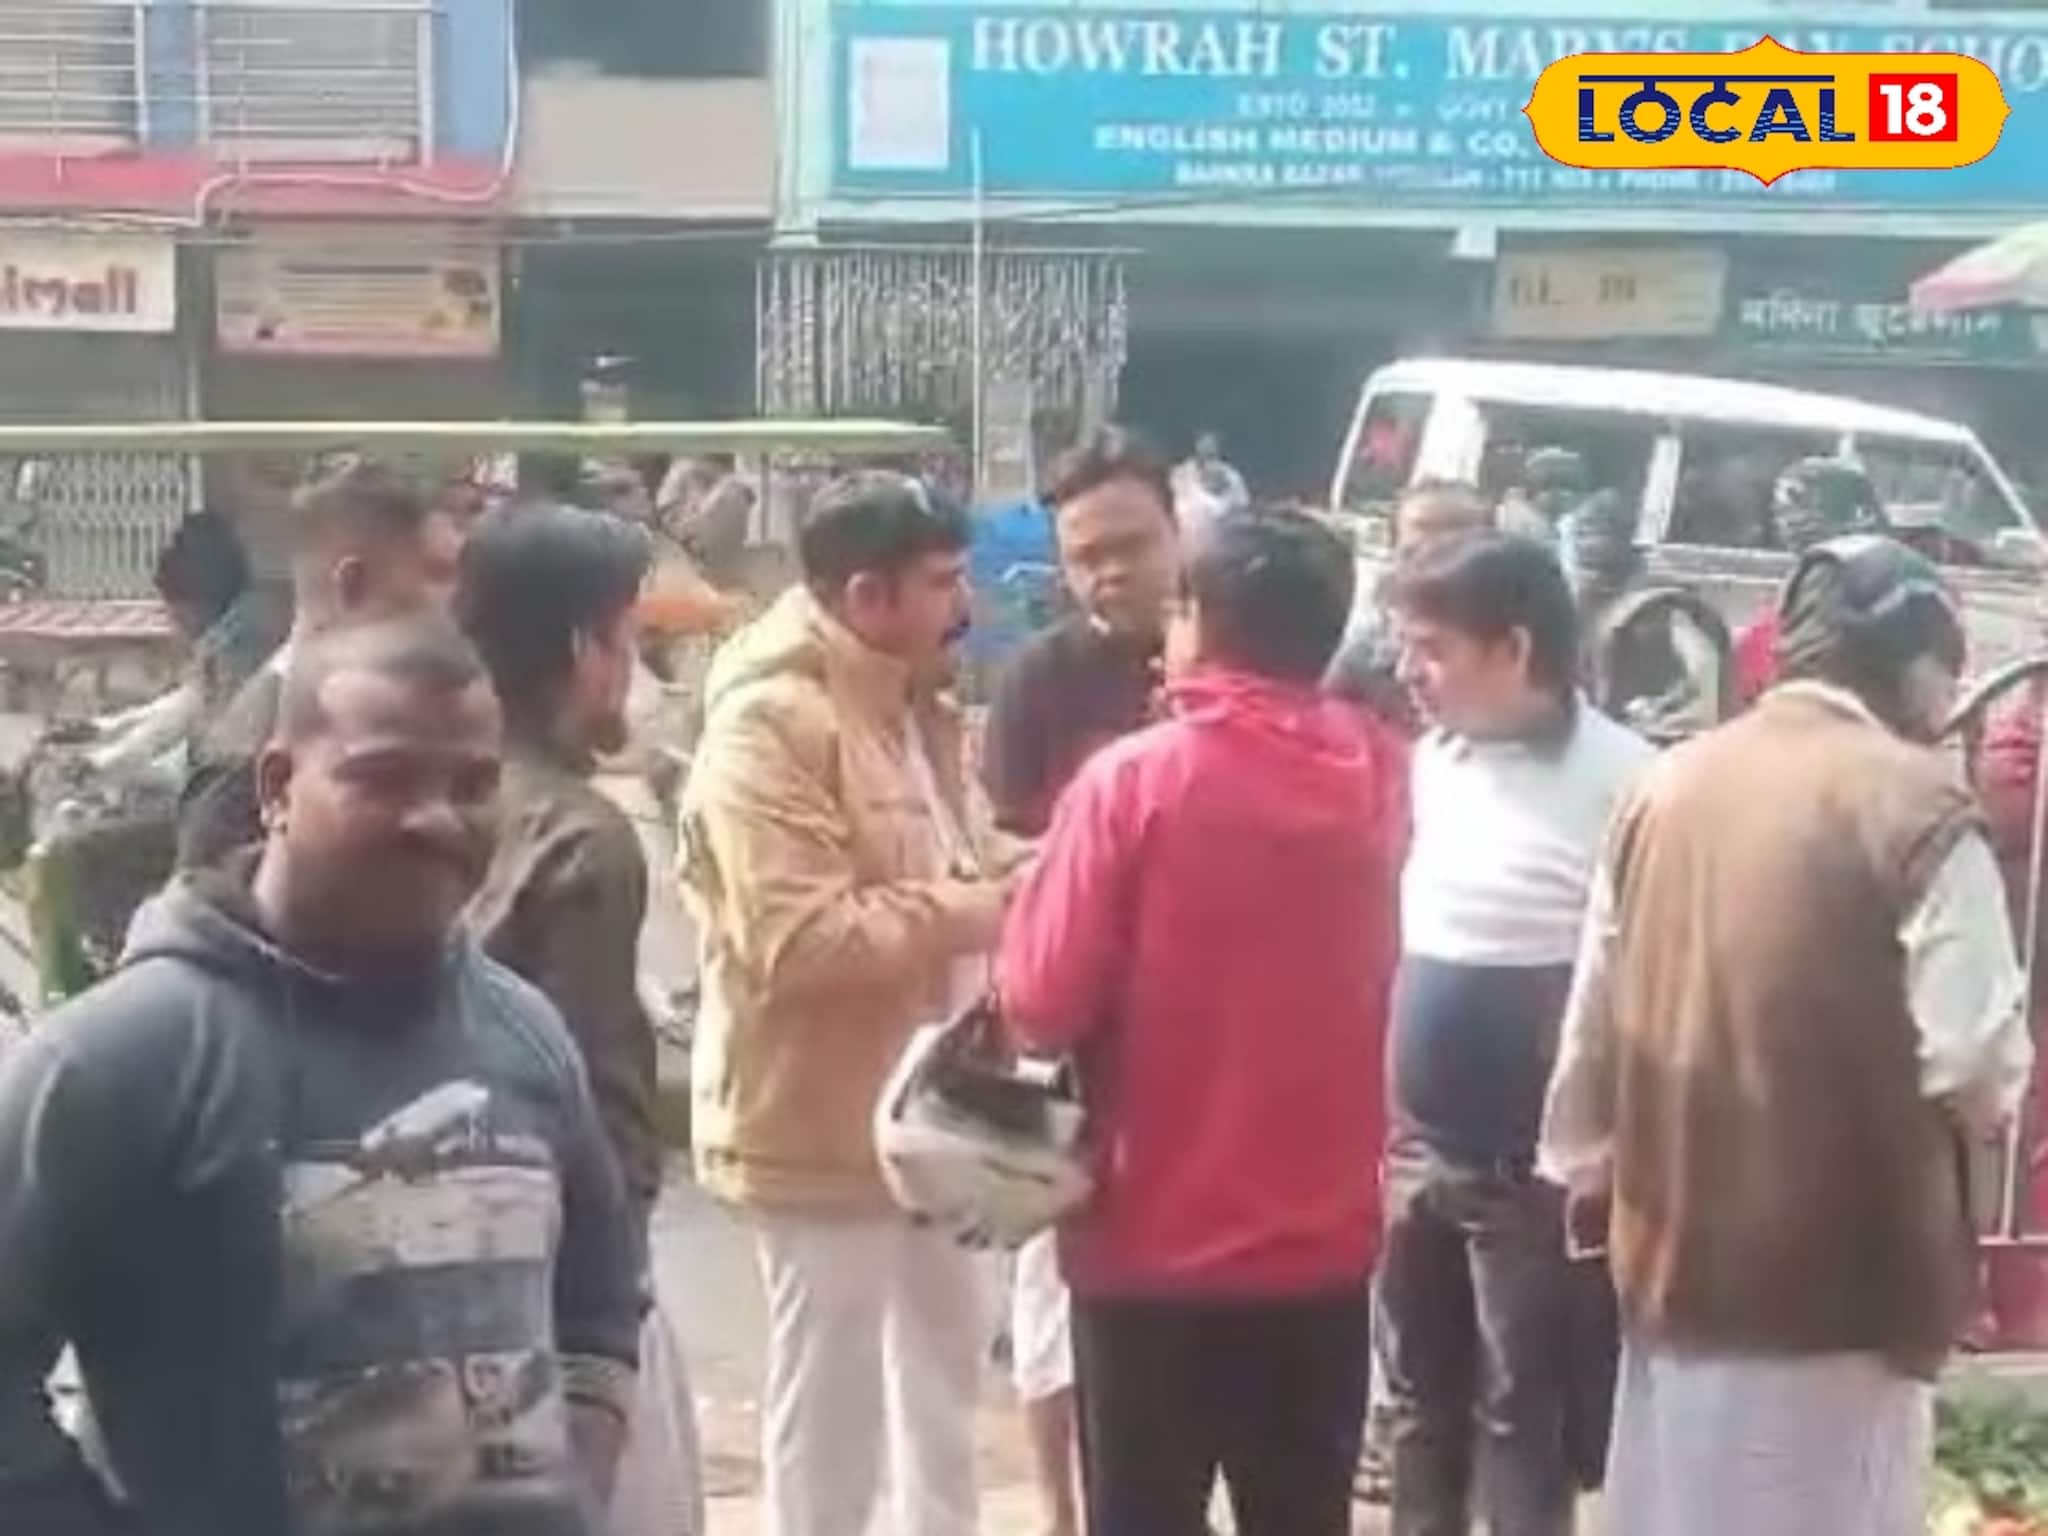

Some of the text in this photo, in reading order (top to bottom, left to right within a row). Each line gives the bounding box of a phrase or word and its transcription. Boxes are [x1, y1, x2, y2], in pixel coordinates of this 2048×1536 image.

[972, 16, 1282, 77] HOWRAH
[1315, 24, 1409, 80] ST.
[1094, 124, 1259, 152] ENGLISH
[1268, 128, 1419, 154] MEDIUM
